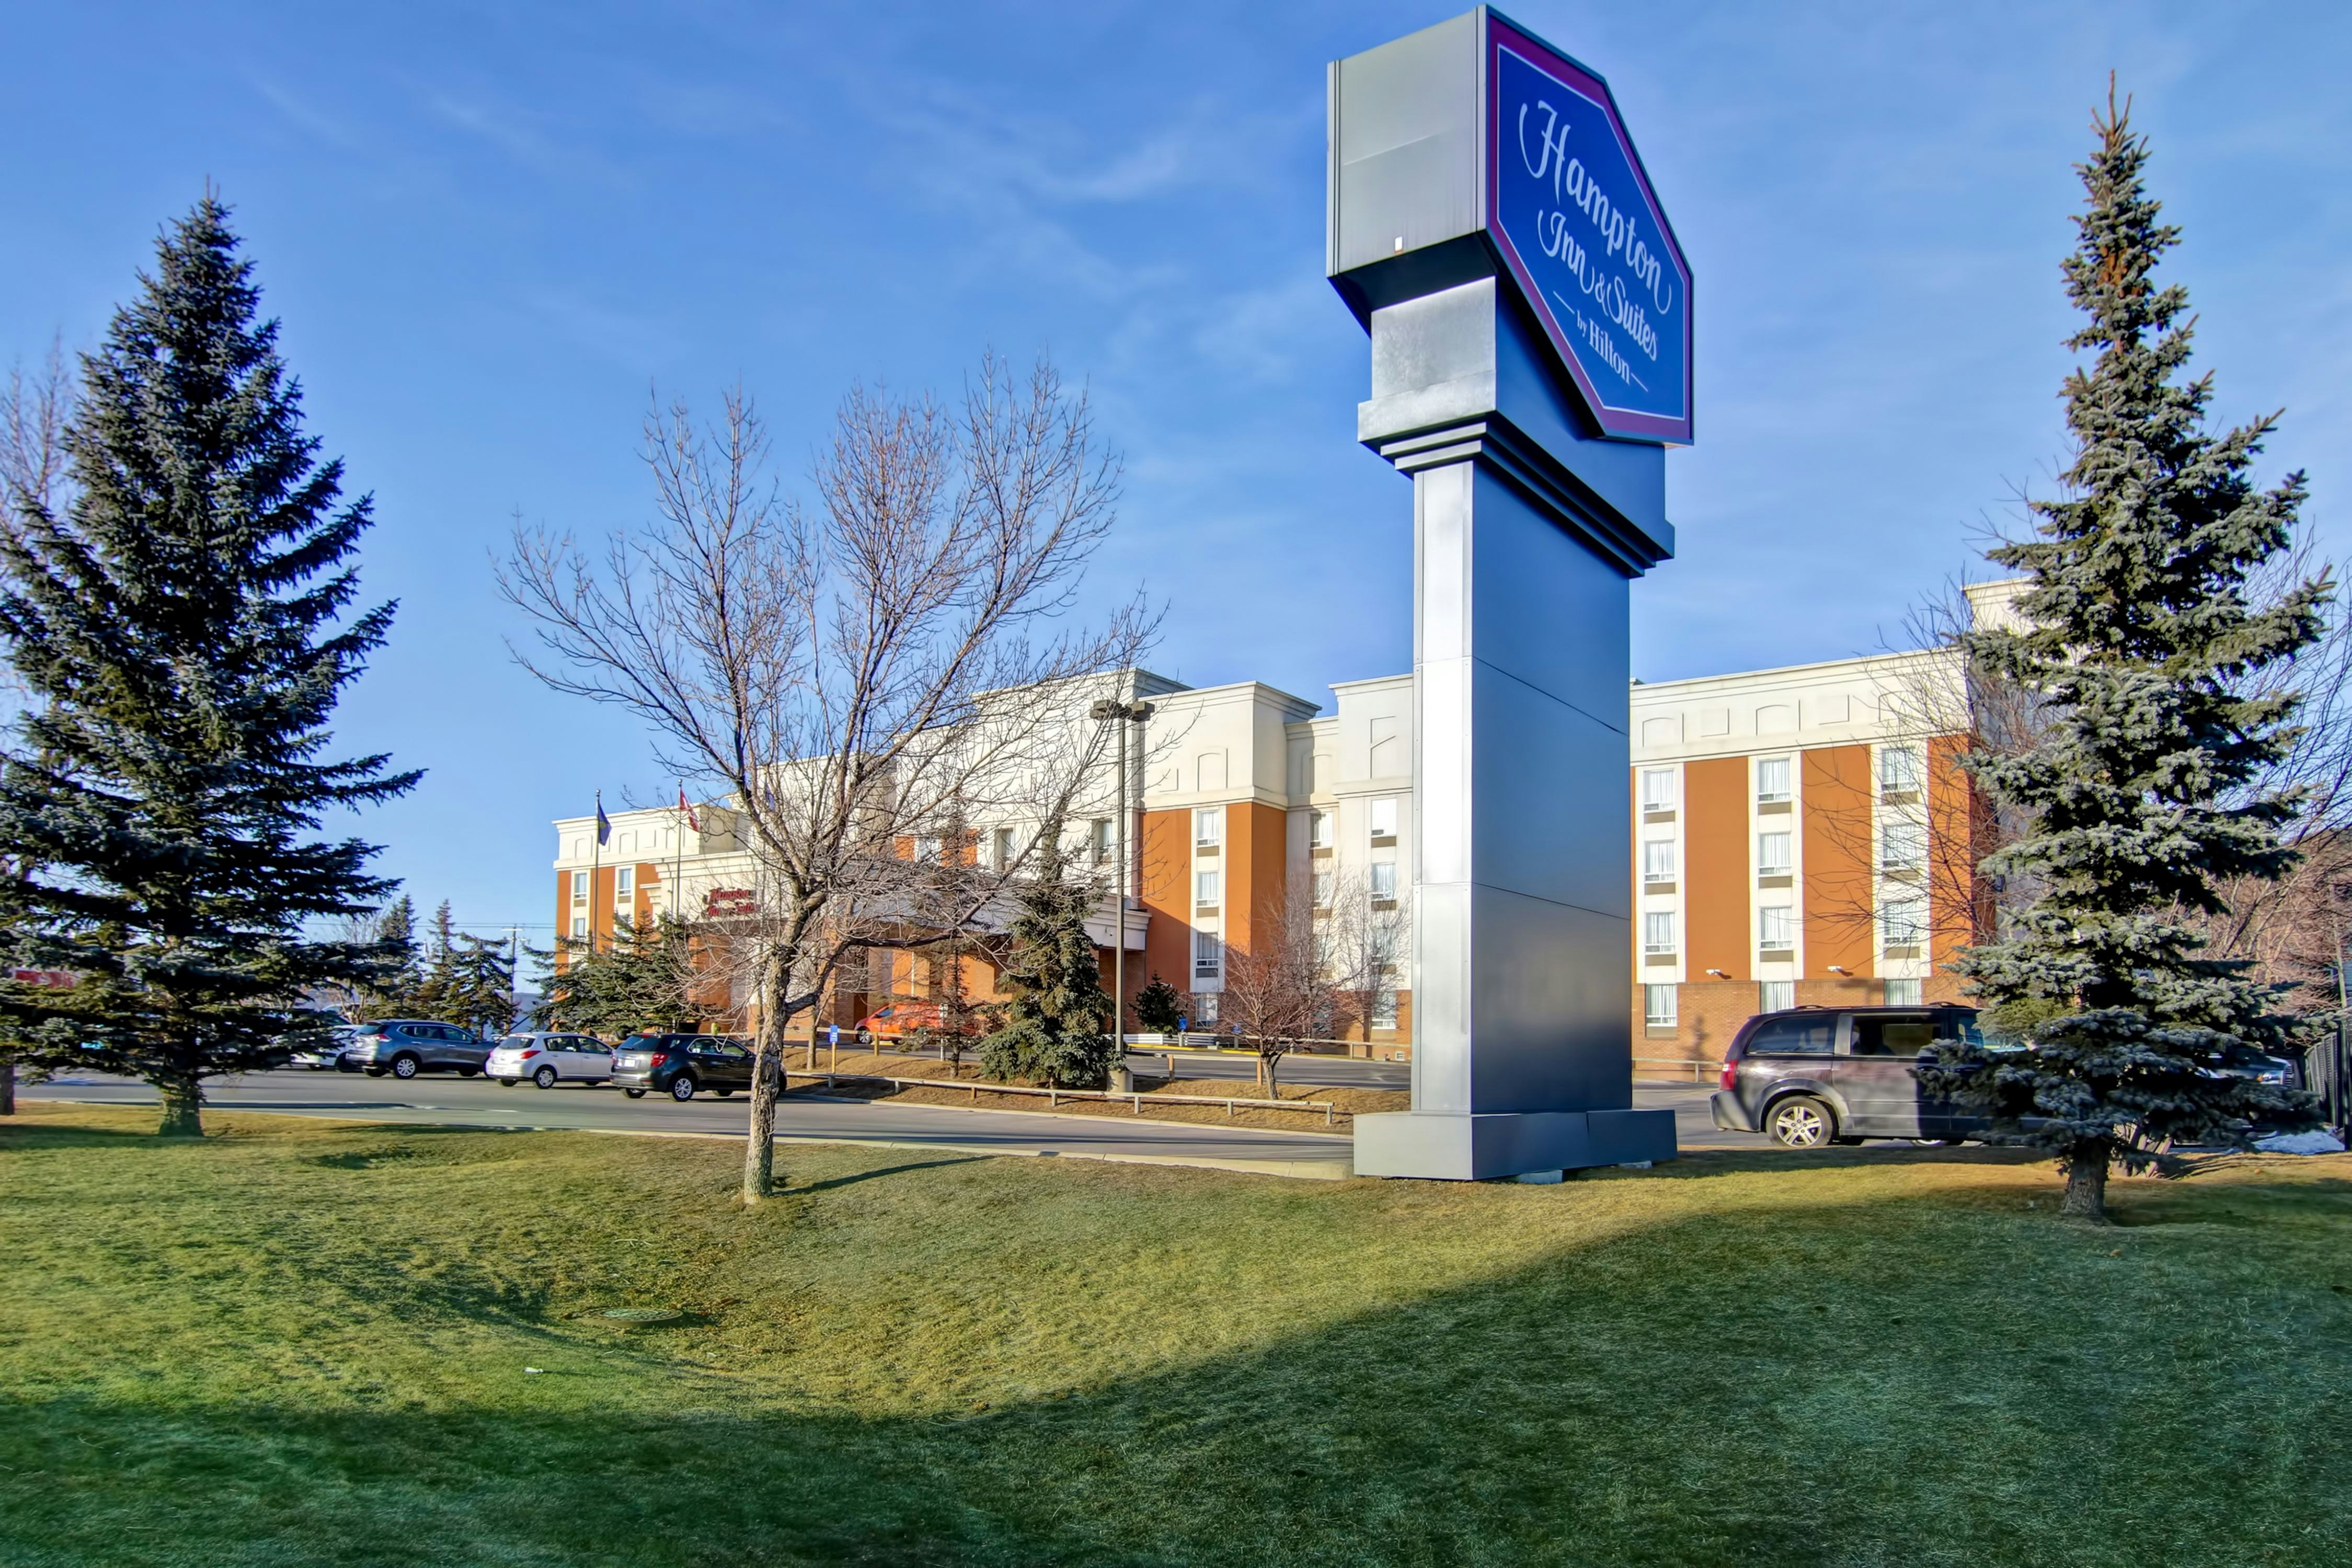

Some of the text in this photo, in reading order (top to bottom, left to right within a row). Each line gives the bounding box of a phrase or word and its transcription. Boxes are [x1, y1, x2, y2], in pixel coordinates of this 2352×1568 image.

[1519, 100, 1671, 314] Hampton
[1538, 210, 1657, 361] Inn & Suites
[1577, 309, 1630, 385] by Hilton
